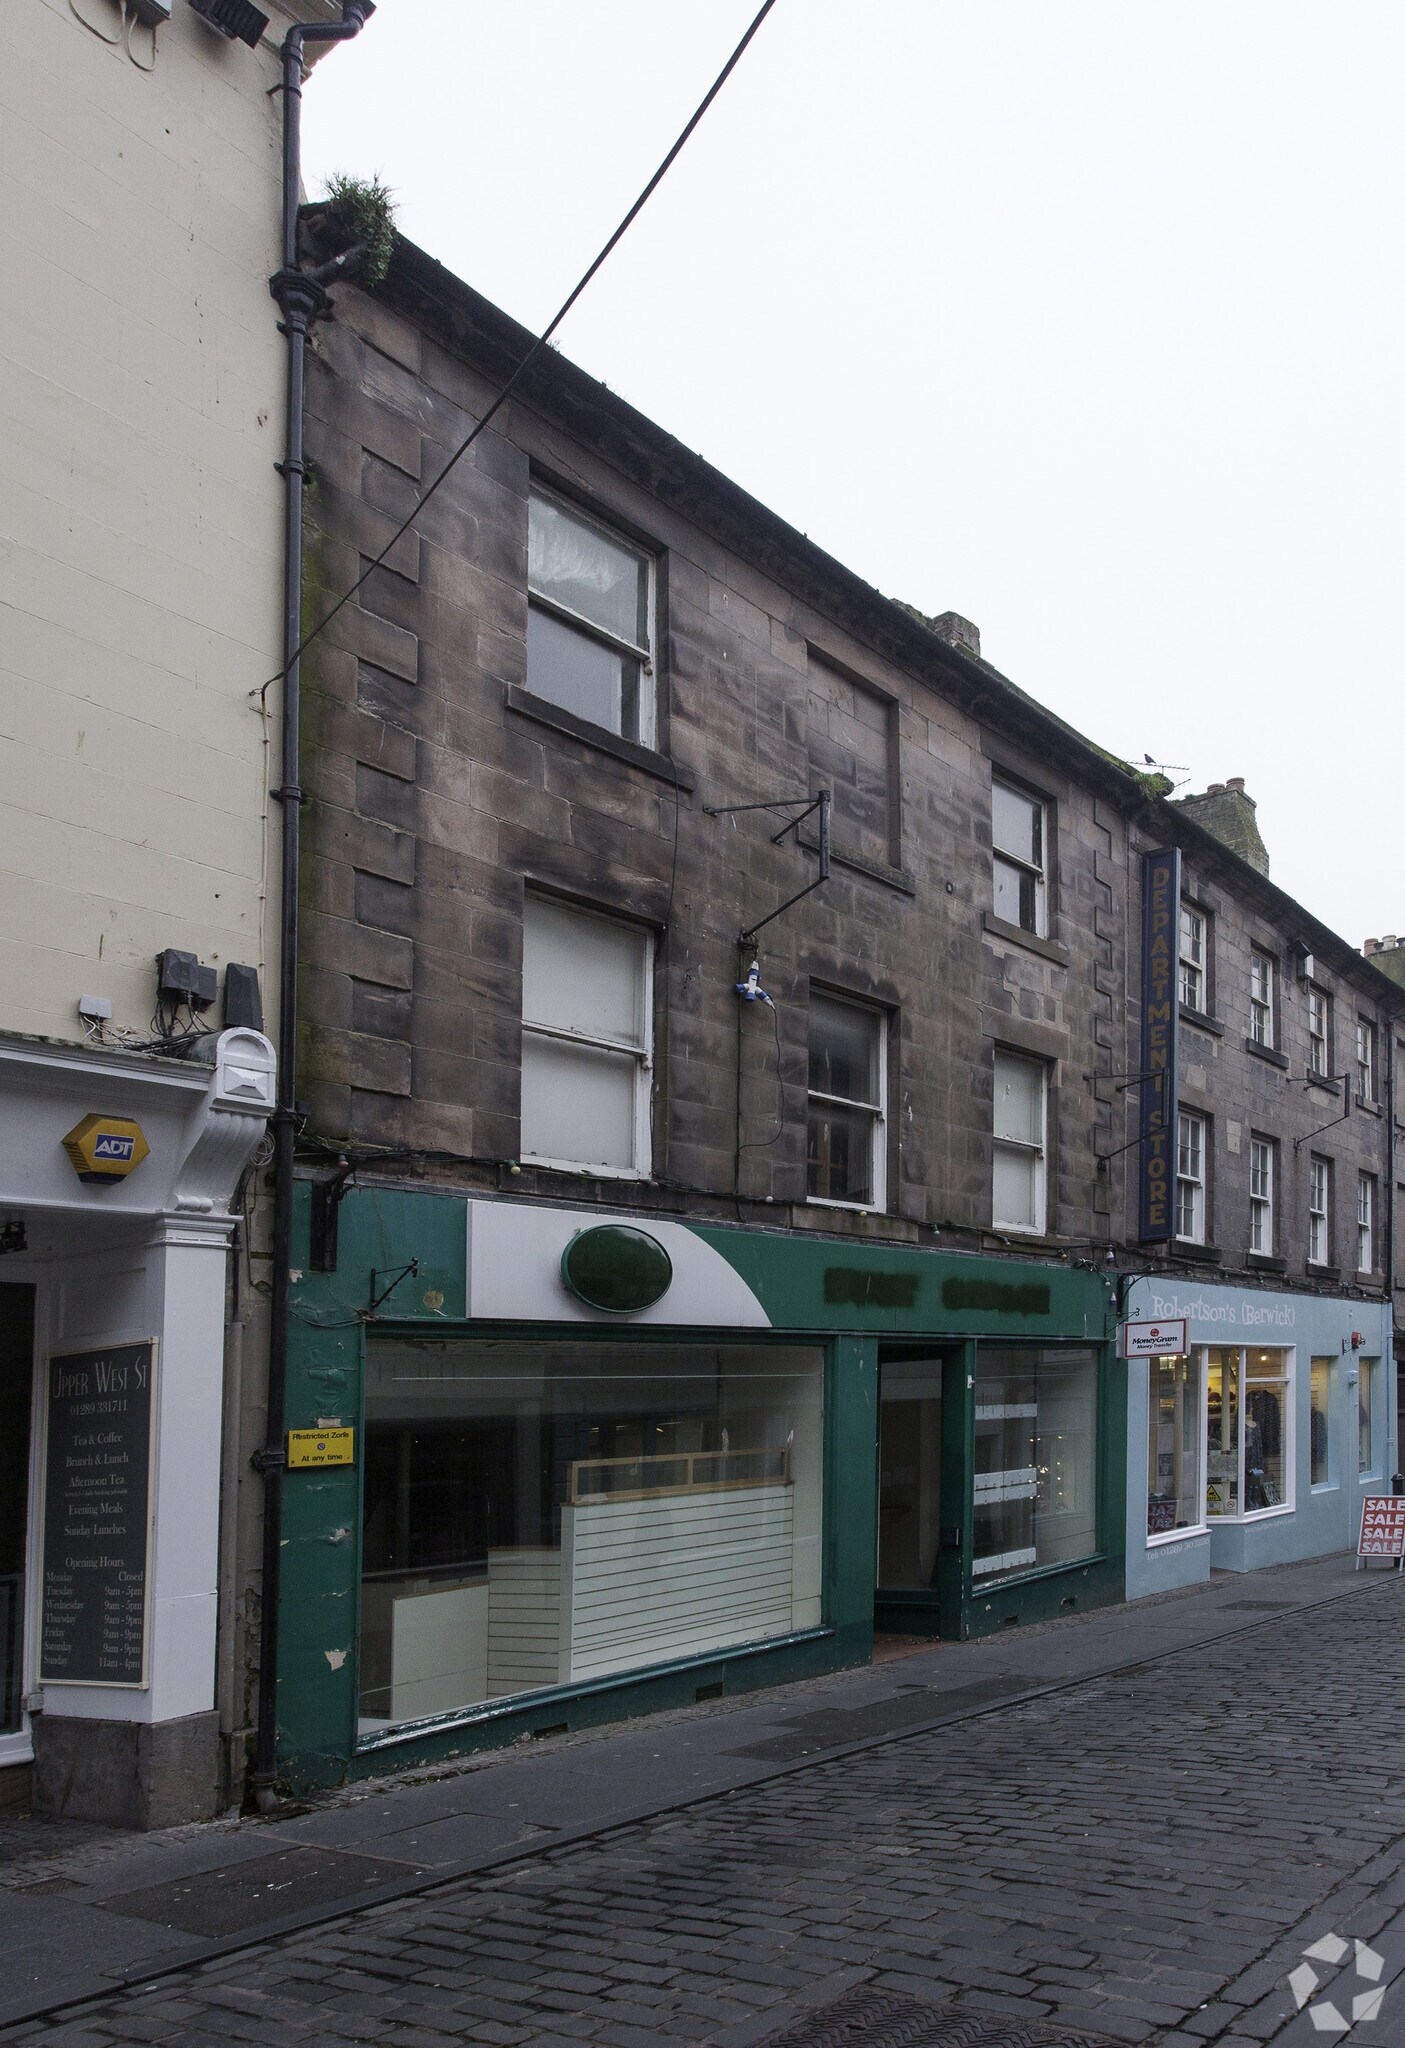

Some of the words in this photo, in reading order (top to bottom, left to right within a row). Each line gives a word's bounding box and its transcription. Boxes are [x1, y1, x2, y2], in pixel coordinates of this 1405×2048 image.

[1147, 866, 1171, 1092] DEPARTMENT
[95, 1140, 133, 1156] ADT
[1148, 1110, 1167, 1226] STORE
[1151, 1294, 1236, 1323] Robertson's
[1241, 1300, 1296, 1327] (Berwick)
[1132, 1336, 1178, 1345] MoneyGram
[70, 1402, 96, 1416] 01289
[71, 1434, 87, 1446] Tea
[88, 1433, 96, 1445] &
[97, 1431, 124, 1444] Coffee
[292, 1432, 330, 1440] Restricted
[331, 1431, 350, 1439] Zone
[66, 1454, 94, 1467] Brunch
[94, 1453, 102, 1465] &
[103, 1451, 129, 1465] Lunch
[312, 1454, 325, 1462] any
[68, 1475, 107, 1487] Afternoon
[108, 1473, 125, 1485] Tea
[68, 1503, 99, 1516] Evening
[100, 1501, 124, 1514] Meals
[1366, 1499, 1405, 1511] SALE
[1364, 1513, 1405, 1525] SALE
[64, 1524, 91, 1537] Sunday
[93, 1522, 127, 1535] Lunches
[1363, 1527, 1403, 1539] SALE
[1361, 1541, 1401, 1553] SALE
[65, 1555, 98, 1570] Opening
[99, 1555, 125, 1568] Hours
[46, 1571, 73, 1583] Monday
[118, 1570, 144, 1582] Closed
[45, 1585, 73, 1598] Tuesday
[104, 1585, 121, 1596] 9am
[125, 1585, 143, 1598] 5pm
[45, 1599, 85, 1612] Wednesday
[104, 1600, 120, 1610] 9am
[125, 1599, 143, 1612] 5pm
[45, 1612, 77, 1625] Thursday
[104, 1614, 120, 1624] 9am
[125, 1614, 142, 1627] 9pm
[44, 1626, 66, 1639] Friday
[103, 1628, 119, 1639] 9am
[124, 1628, 141, 1641] 9pm
[44, 1641, 73, 1653] Saturday
[102, 1642, 118, 1653] 9am
[124, 1642, 141, 1655] 9pm
[43, 1655, 68, 1667] Sunday
